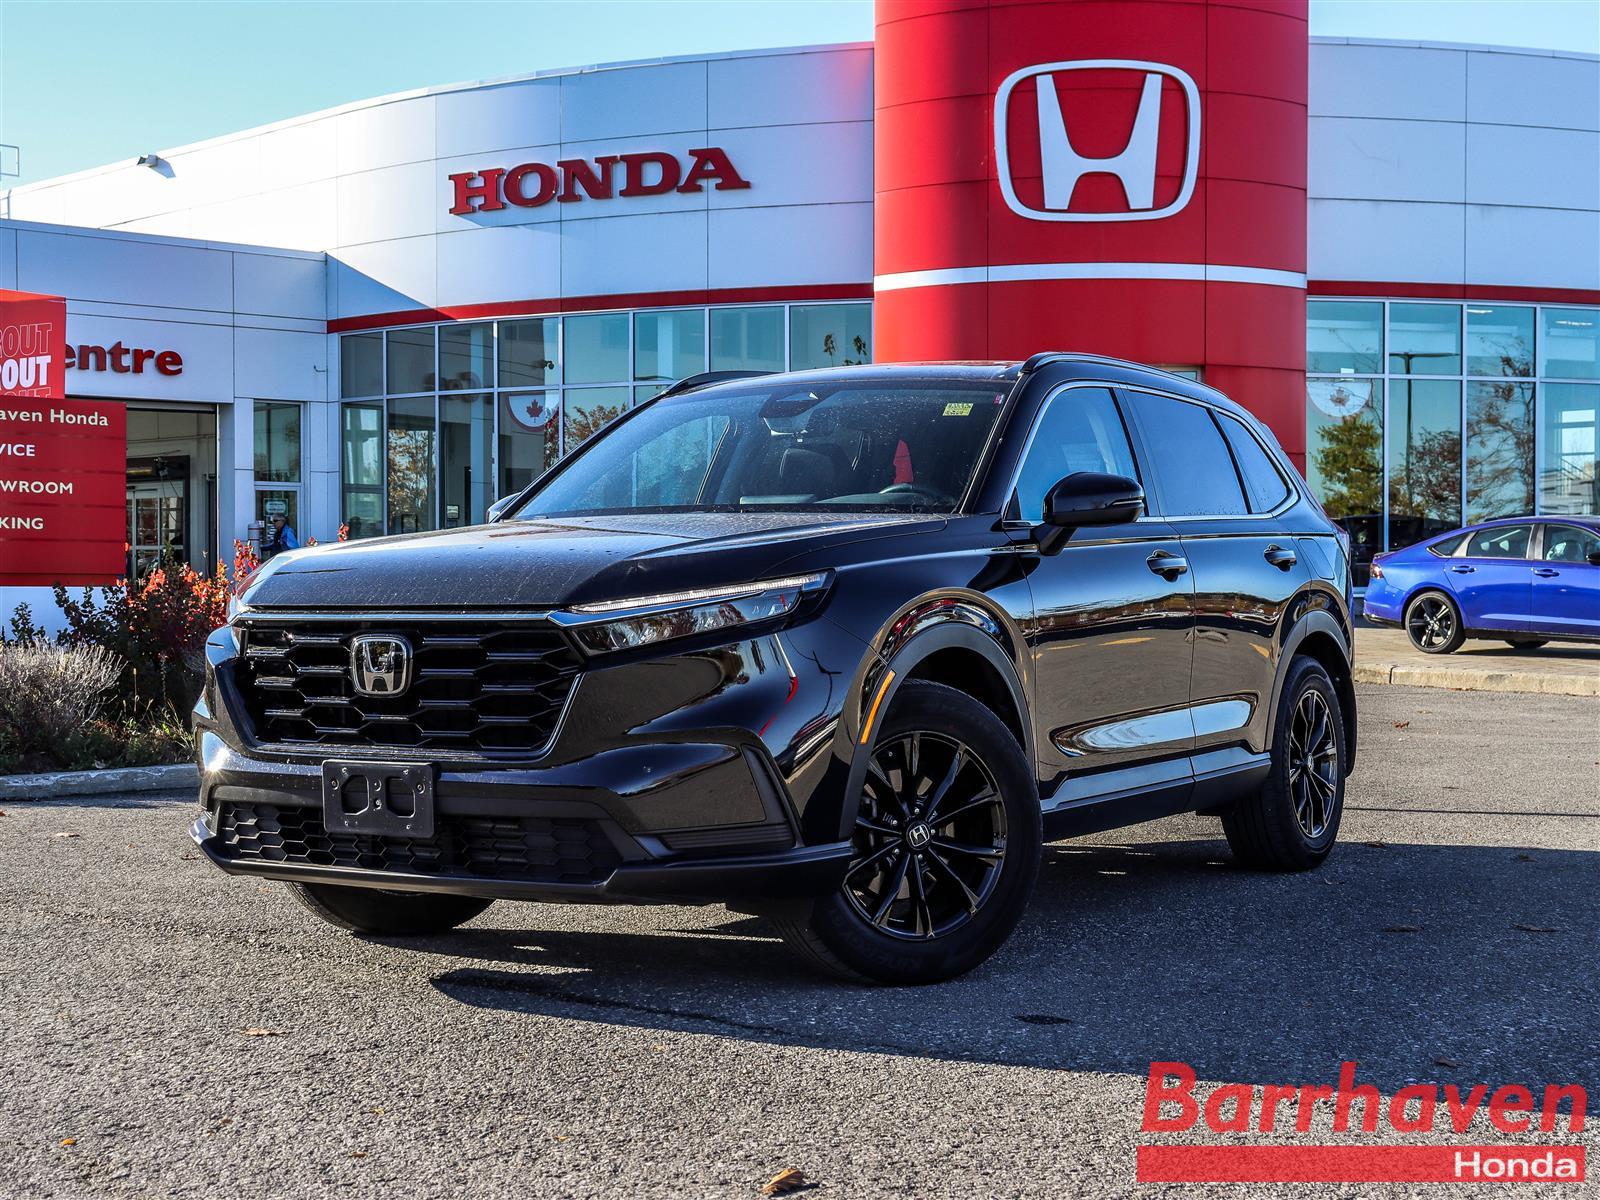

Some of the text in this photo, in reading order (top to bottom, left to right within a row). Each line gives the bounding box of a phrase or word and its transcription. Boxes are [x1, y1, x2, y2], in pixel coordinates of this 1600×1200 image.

[1036, 73, 1163, 210] H
[448, 147, 752, 215] HONDA
[0, 322, 53, 358] OUT
[0, 355, 52, 390] OUT
[0, 408, 109, 426] aven Honda
[0, 480, 73, 495] WROOM
[0, 517, 44, 530] KING
